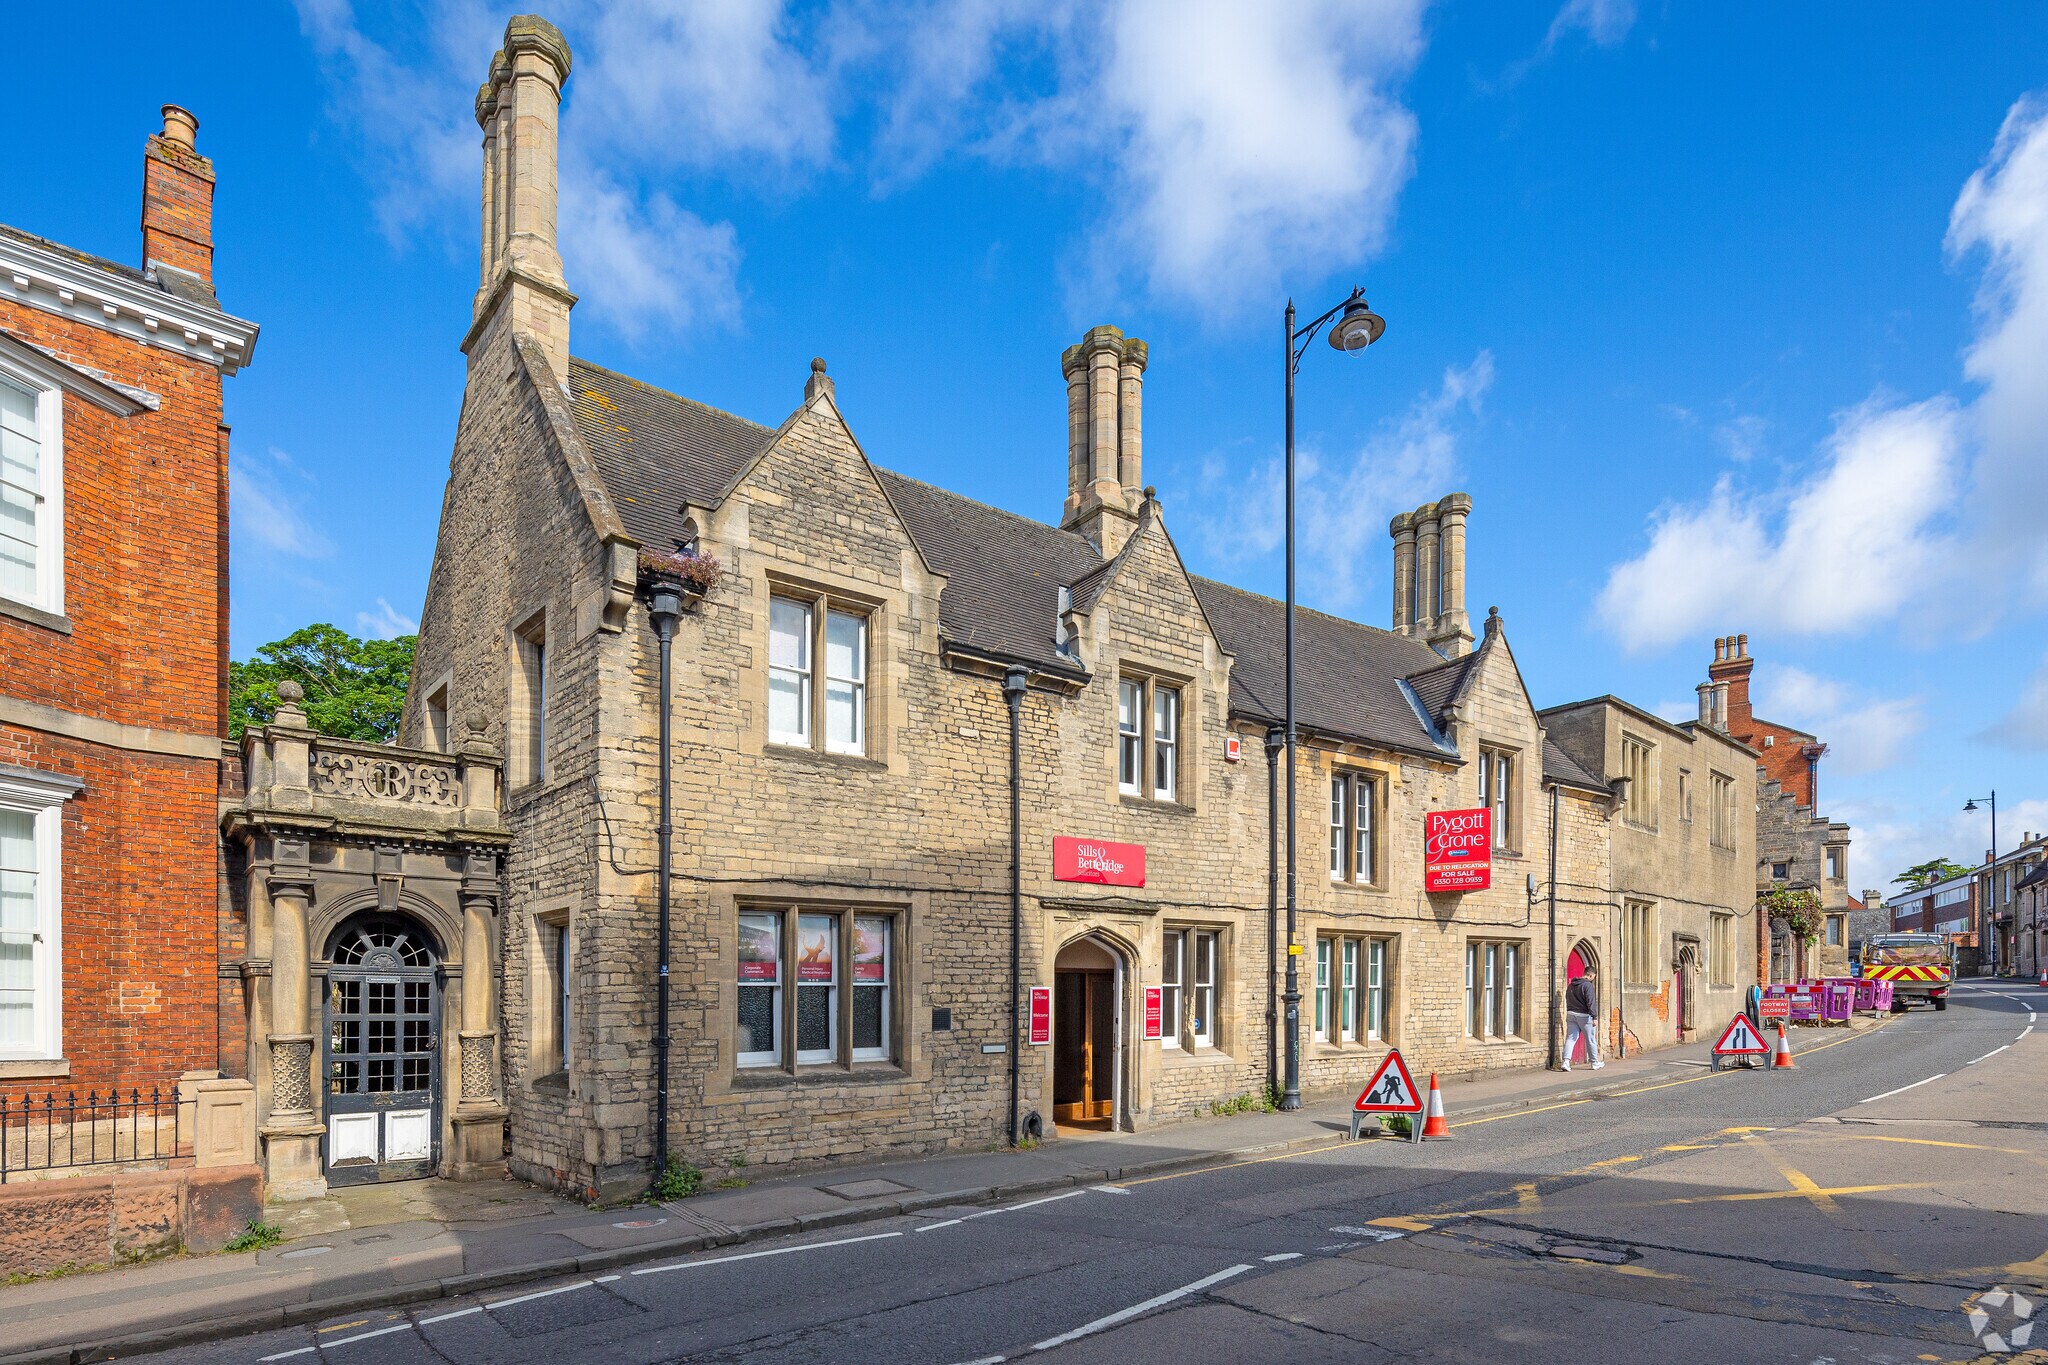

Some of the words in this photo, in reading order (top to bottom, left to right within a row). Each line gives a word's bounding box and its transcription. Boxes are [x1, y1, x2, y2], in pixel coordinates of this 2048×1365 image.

[1433, 813, 1484, 833] Pygott
[1438, 834, 1484, 848] Crone
[1078, 844, 1098, 858] Sills
[1078, 857, 1124, 874] Betteridge
